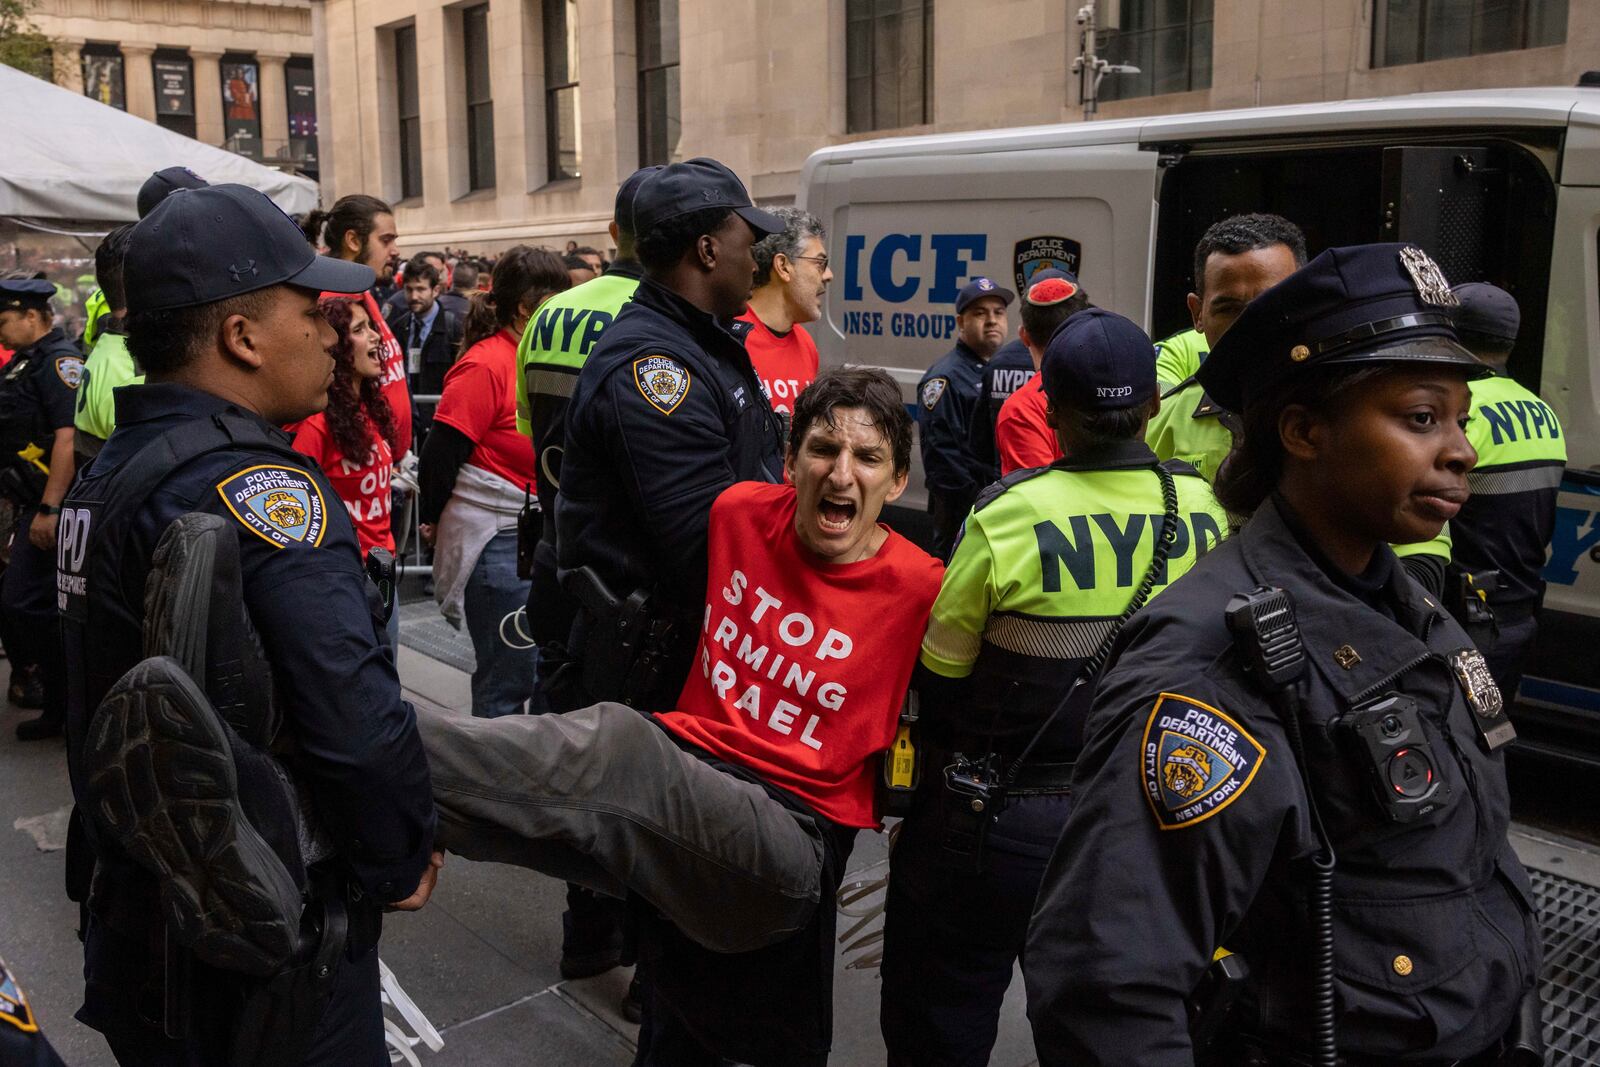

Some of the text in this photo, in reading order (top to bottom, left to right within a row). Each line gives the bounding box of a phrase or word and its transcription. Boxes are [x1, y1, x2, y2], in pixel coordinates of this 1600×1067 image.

[1018, 248, 1076, 264] DEPARTMENT
[1031, 240, 1064, 249] POLICE
[531, 308, 613, 355] NYP
[891, 313, 956, 339] GROUP
[639, 363, 685, 375] DEPARTMENT
[648, 357, 674, 367] POLICE
[640, 381, 660, 404] CITY OF
[1096, 386, 1132, 398] NYPD
[1478, 400, 1559, 445] NYPD
[235, 479, 310, 503] DEPARTMENT
[245, 471, 290, 486] POLICE
[360, 463, 393, 495] OU
[245, 512, 290, 544] CITY OF
[306, 495, 322, 544] NEW YORK
[58, 508, 91, 573] PD
[1033, 512, 1223, 593] NYPD
[722, 570, 853, 661] STOP
[704, 603, 848, 711] RMING
[1159, 716, 1247, 770] DEPARTMENT
[1184, 709, 1238, 745] POLICE
[1146, 742, 1160, 801] CITY OF
[1175, 777, 1240, 821] NEW YORK
